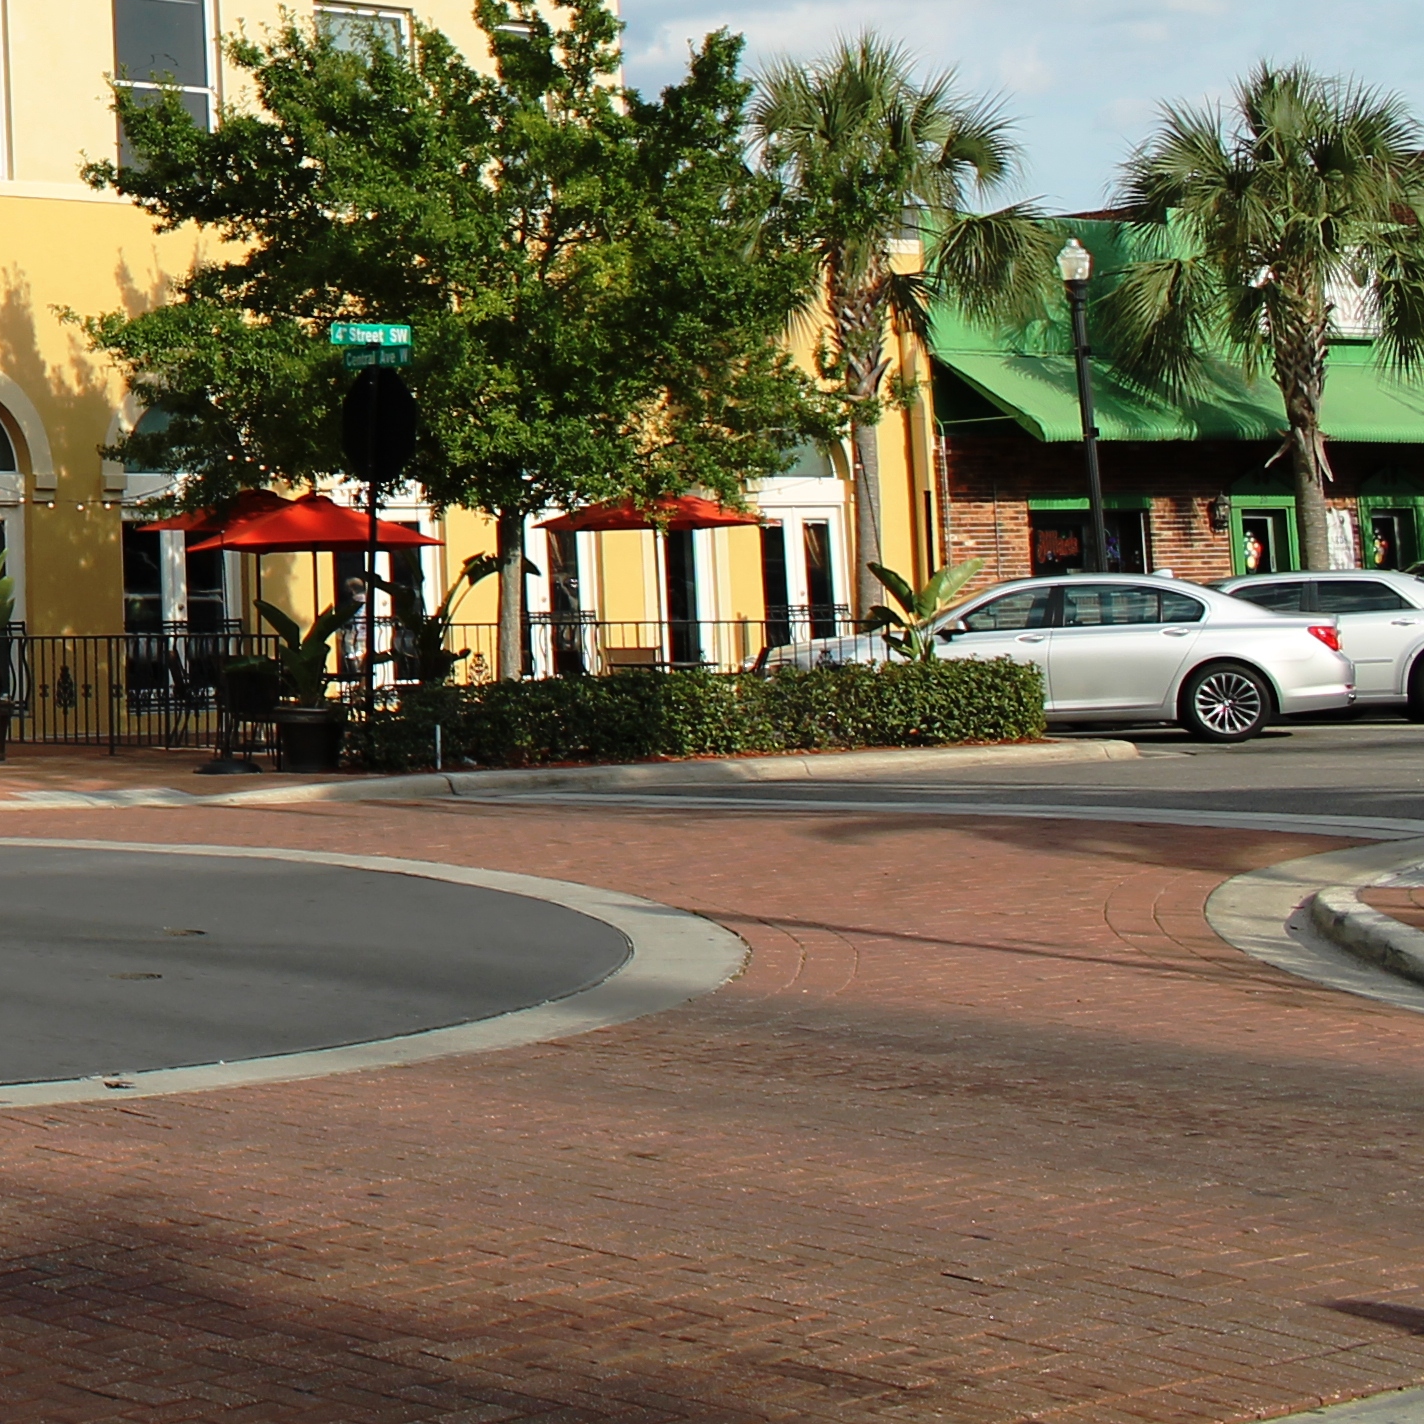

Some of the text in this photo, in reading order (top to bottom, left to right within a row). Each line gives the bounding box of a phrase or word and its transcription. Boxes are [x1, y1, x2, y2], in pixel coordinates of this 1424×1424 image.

[349, 327, 384, 343] Street
[389, 328, 408, 343] SW
[346, 348, 408, 366] Central Ave W
